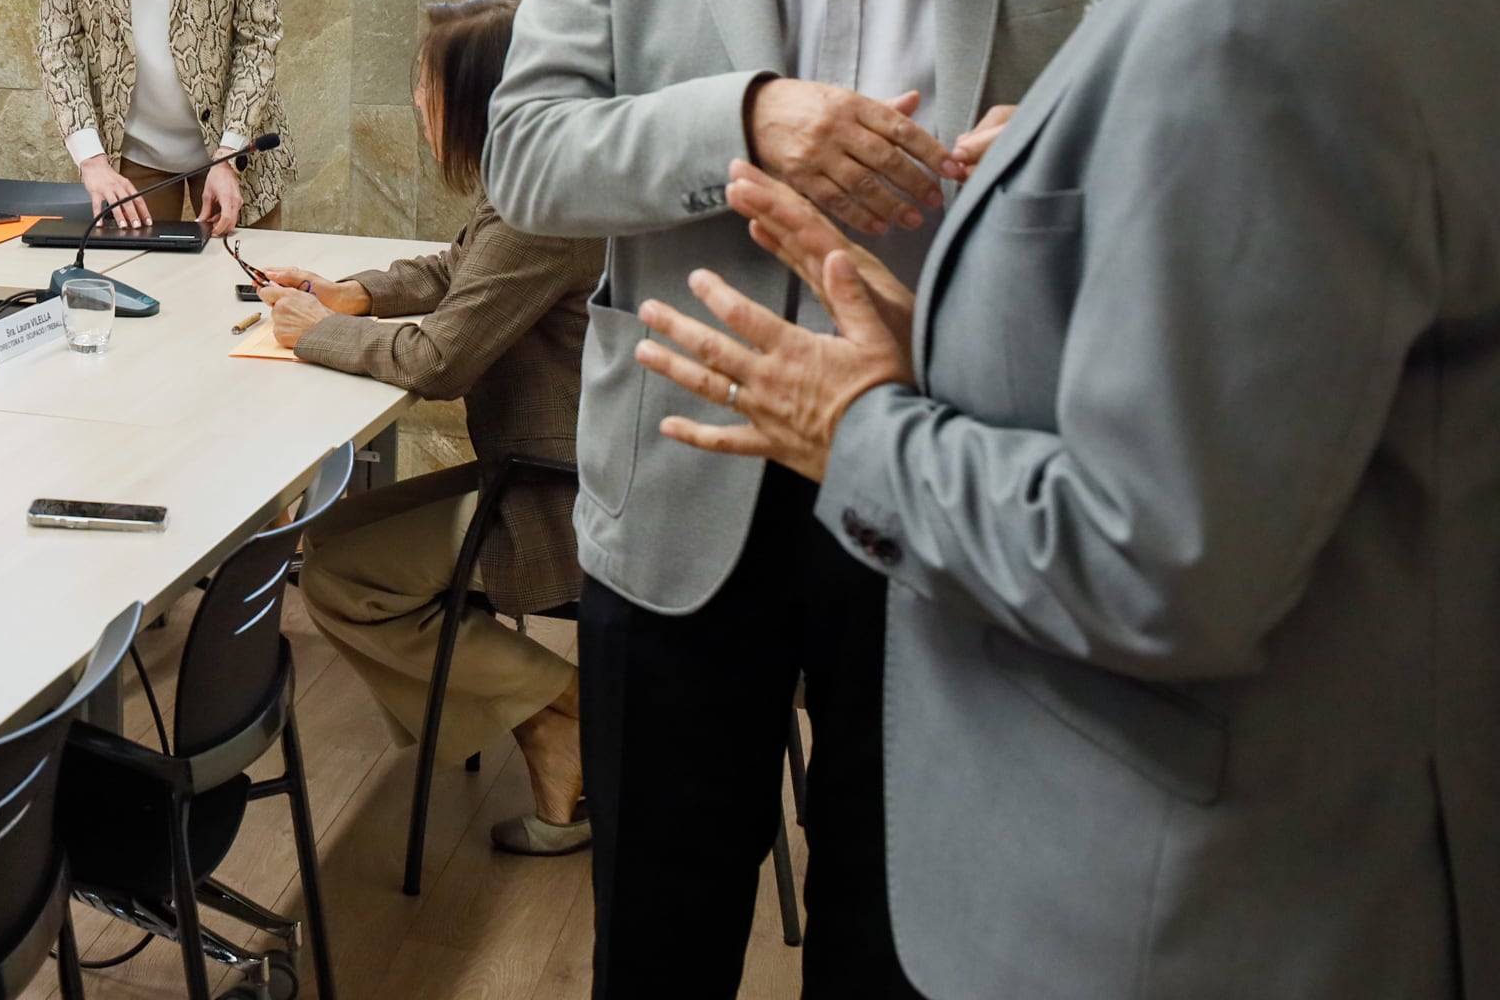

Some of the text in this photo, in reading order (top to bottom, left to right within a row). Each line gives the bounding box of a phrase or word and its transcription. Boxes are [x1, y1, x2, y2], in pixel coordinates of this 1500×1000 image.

[16, 322, 31, 333] Laura
[30, 312, 51, 326] VILELLA
[0, 338, 20, 352] DIRECTORA
